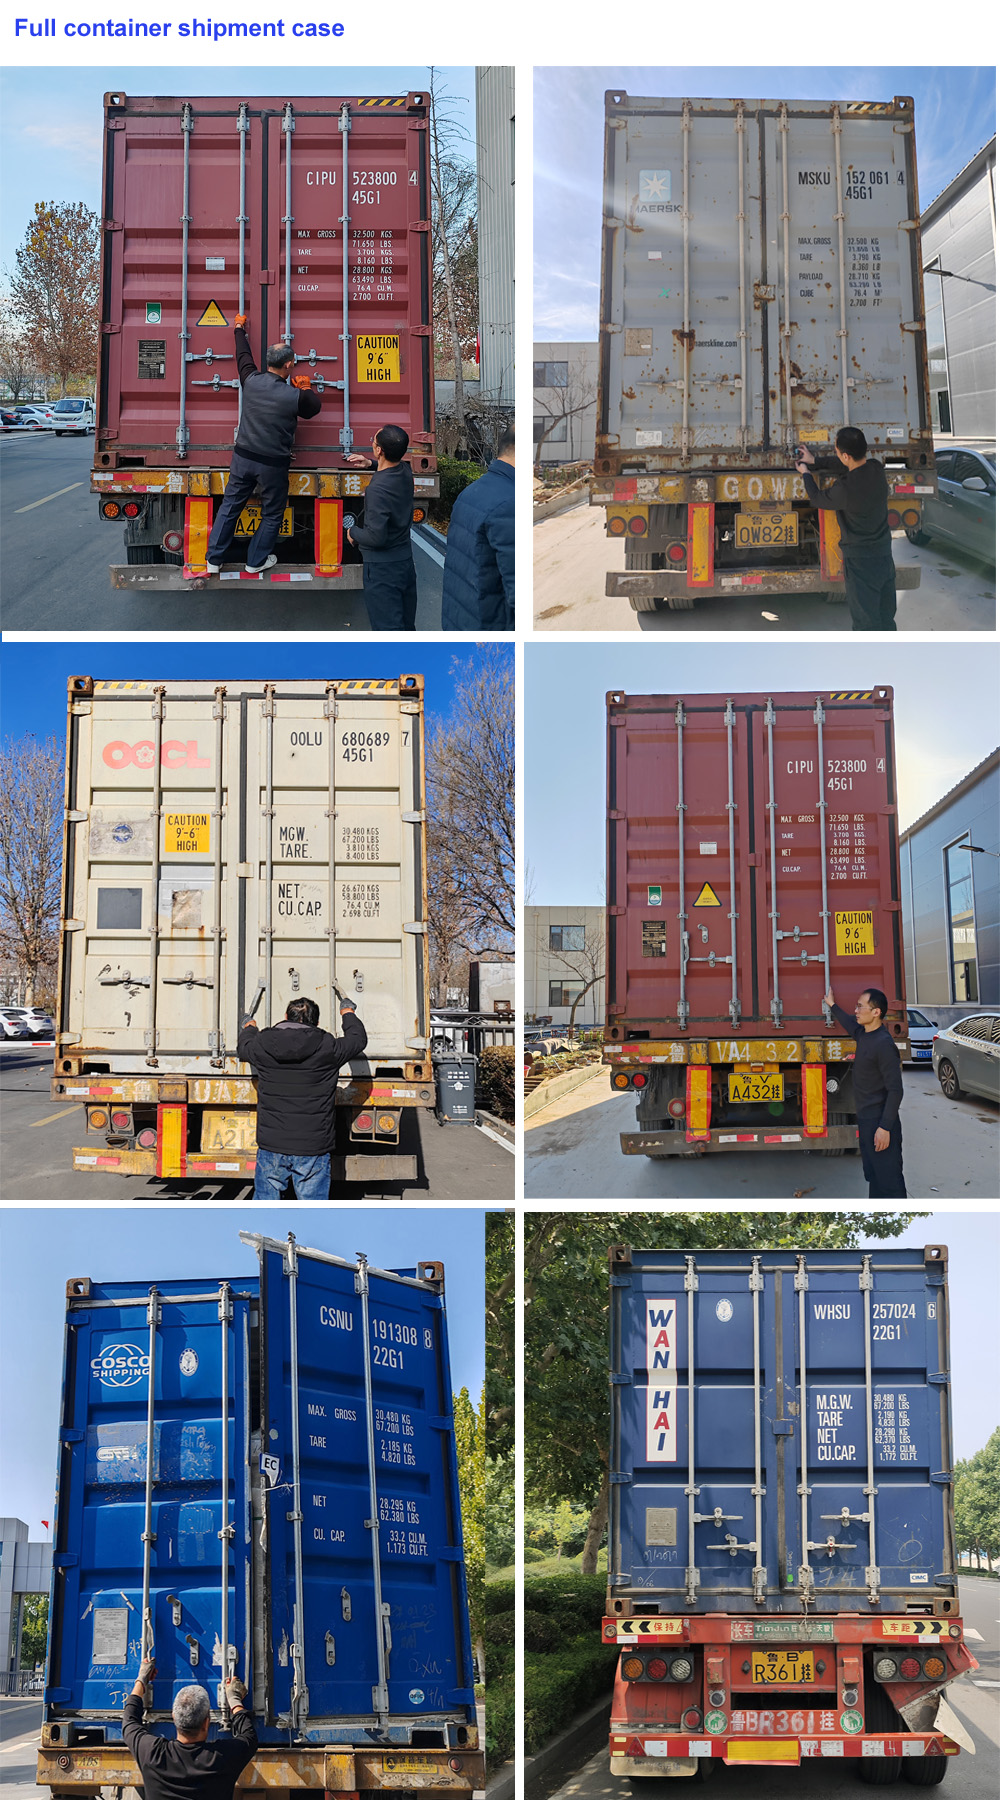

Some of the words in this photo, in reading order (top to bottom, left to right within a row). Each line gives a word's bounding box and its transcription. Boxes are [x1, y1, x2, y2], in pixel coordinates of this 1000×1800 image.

[306, 171, 336, 185] CIPU
[352, 171, 397, 185] 523800
[409, 170, 417, 185] 4
[798, 171, 831, 185] MSKU
[846, 171, 866, 185] 152
[869, 171, 889, 184] 061
[897, 171, 905, 185] 4
[352, 190, 380, 204] 45G1
[845, 186, 873, 200] 45G1
[297, 230, 310, 238] MAX
[317, 230, 336, 238] GROSS
[352, 230, 375, 238] 32.500
[352, 240, 374, 248] 71.650
[380, 240, 393, 248] LBS.
[799, 253, 813, 261] TARE
[297, 266, 308, 274] NET
[352, 266, 375, 274] 28.800
[352, 276, 374, 284] 63.490
[380, 276, 393, 284] LBS.
[357, 336, 398, 349] CAUTION
[366, 368, 391, 380] HIGH
[341, 731, 390, 746] 680689
[402, 731, 410, 746] 7
[102, 740, 211, 769] OOCL
[342, 748, 373, 762] 45G1
[787, 760, 813, 774] CIPU
[827, 759, 867, 773] 523800
[877, 758, 885, 772] 4
[827, 777, 853, 791] 45G1
[168, 815, 207, 826] CAUTION
[797, 815, 815, 823] GROSS
[279, 826, 309, 841] MGW.
[342, 827, 365, 836] 30.480
[366, 827, 379, 836] KGS
[829, 823, 849, 831] 71.650
[176, 840, 198, 851] HIGH
[280, 843, 312, 858] TARE.
[781, 848, 791, 856] NET
[346, 852, 365, 860] 8.400
[366, 852, 379, 860] LBS
[278, 883, 304, 898] NET.
[342, 884, 365, 892] 26.670
[366, 884, 379, 892] KGS
[278, 901, 322, 916] CU.CAP.
[346, 901, 361, 909] 76.4
[836, 912, 872, 925] CAUTION
[844, 942, 866, 954] HIGH
[814, 1304, 850, 1320] WHSU
[872, 1303, 916, 1319] 257024
[927, 1303, 936, 1319] 6
[320, 1305, 353, 1331] CSNU
[372, 1319, 418, 1346] 191308
[424, 1329, 432, 1348] 8
[872, 1325, 900, 1340] 22G1
[648, 1309, 674, 1369] WAN
[90, 1355, 150, 1369] COSCO
[373, 1345, 404, 1370] 22G1
[92, 1368, 150, 1378] SHIPPING
[816, 1394, 853, 1410] M.G.W.
[898, 1393, 907, 1402] KG
[898, 1402, 909, 1410] LBS
[307, 1403, 327, 1417] MAX.
[334, 1408, 357, 1421] GROSS
[375, 1409, 399, 1423] 30.480
[401, 1413, 411, 1425] KG
[652, 1390, 671, 1451] HAI
[817, 1411, 843, 1427] TARE
[898, 1411, 908, 1419] KG
[375, 1420, 400, 1434] 67.200
[401, 1425, 414, 1437] LBS
[899, 1419, 910, 1427] LBS
[817, 1428, 838, 1444] NET
[899, 1428, 908, 1436] KG
[900, 1436, 911, 1444] LBS
[309, 1435, 327, 1448] TARE
[380, 1439, 400, 1451] 2.185
[402, 1443, 412, 1454] KG
[381, 1451, 401, 1463] 4.820
[403, 1454, 416, 1466] LBS
[817, 1445, 856, 1461] CU.CAP.
[264, 1457, 277, 1471] EC
[312, 1494, 327, 1507] NET
[379, 1497, 404, 1511] 28.295
[406, 1501, 416, 1512] KG
[380, 1509, 405, 1523] 62.380
[407, 1512, 420, 1524] LBS
[313, 1527, 326, 1540] CU.
[330, 1529, 346, 1542] CAP.
[389, 1529, 406, 1542] 33.2
[387, 1541, 406, 1555] 1.173
[653, 1621, 675, 1632] 保持
[889, 1622, 911, 1632] 车距
